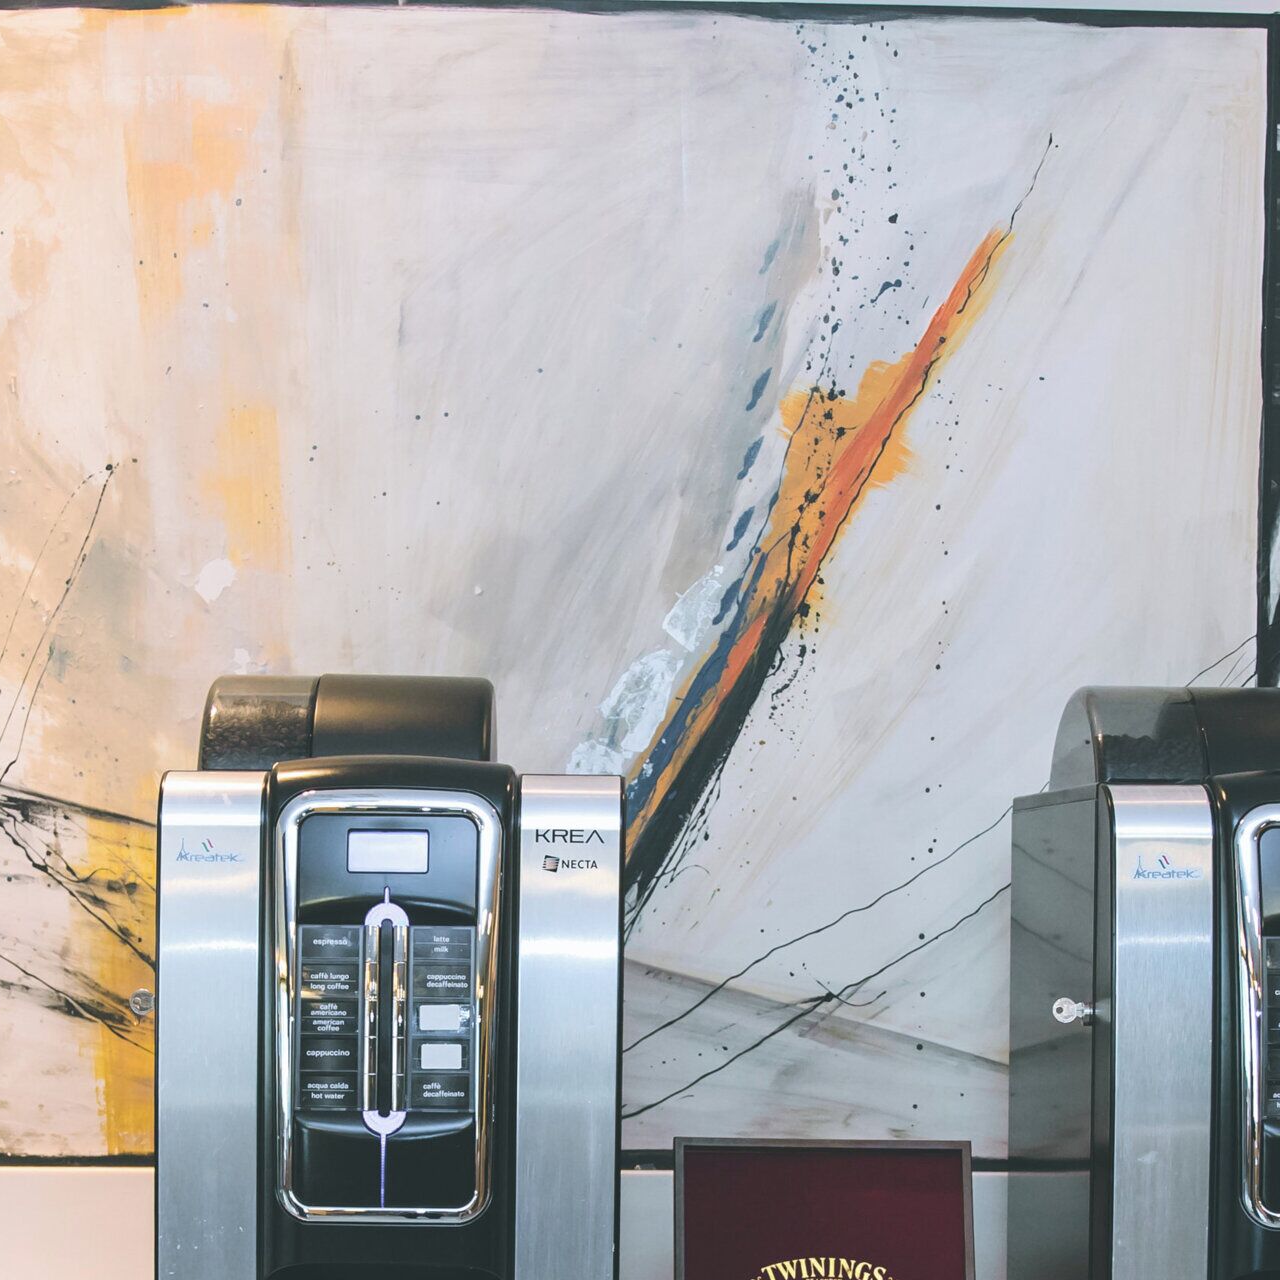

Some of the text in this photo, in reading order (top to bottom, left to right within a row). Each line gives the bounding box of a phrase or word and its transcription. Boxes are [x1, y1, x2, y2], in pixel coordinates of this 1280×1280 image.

[535, 829, 605, 844] KREA
[176, 850, 238, 862] Kreatek
[561, 860, 598, 869] NECTA
[1134, 868, 1195, 879] Kreatek
[313, 939, 348, 947] espresso
[330, 972, 350, 981] lungo
[310, 983, 326, 991] long
[306, 1049, 351, 1057] cappuccino
[307, 1083, 329, 1091] acqua
[423, 1090, 465, 1098] decaffeinato
